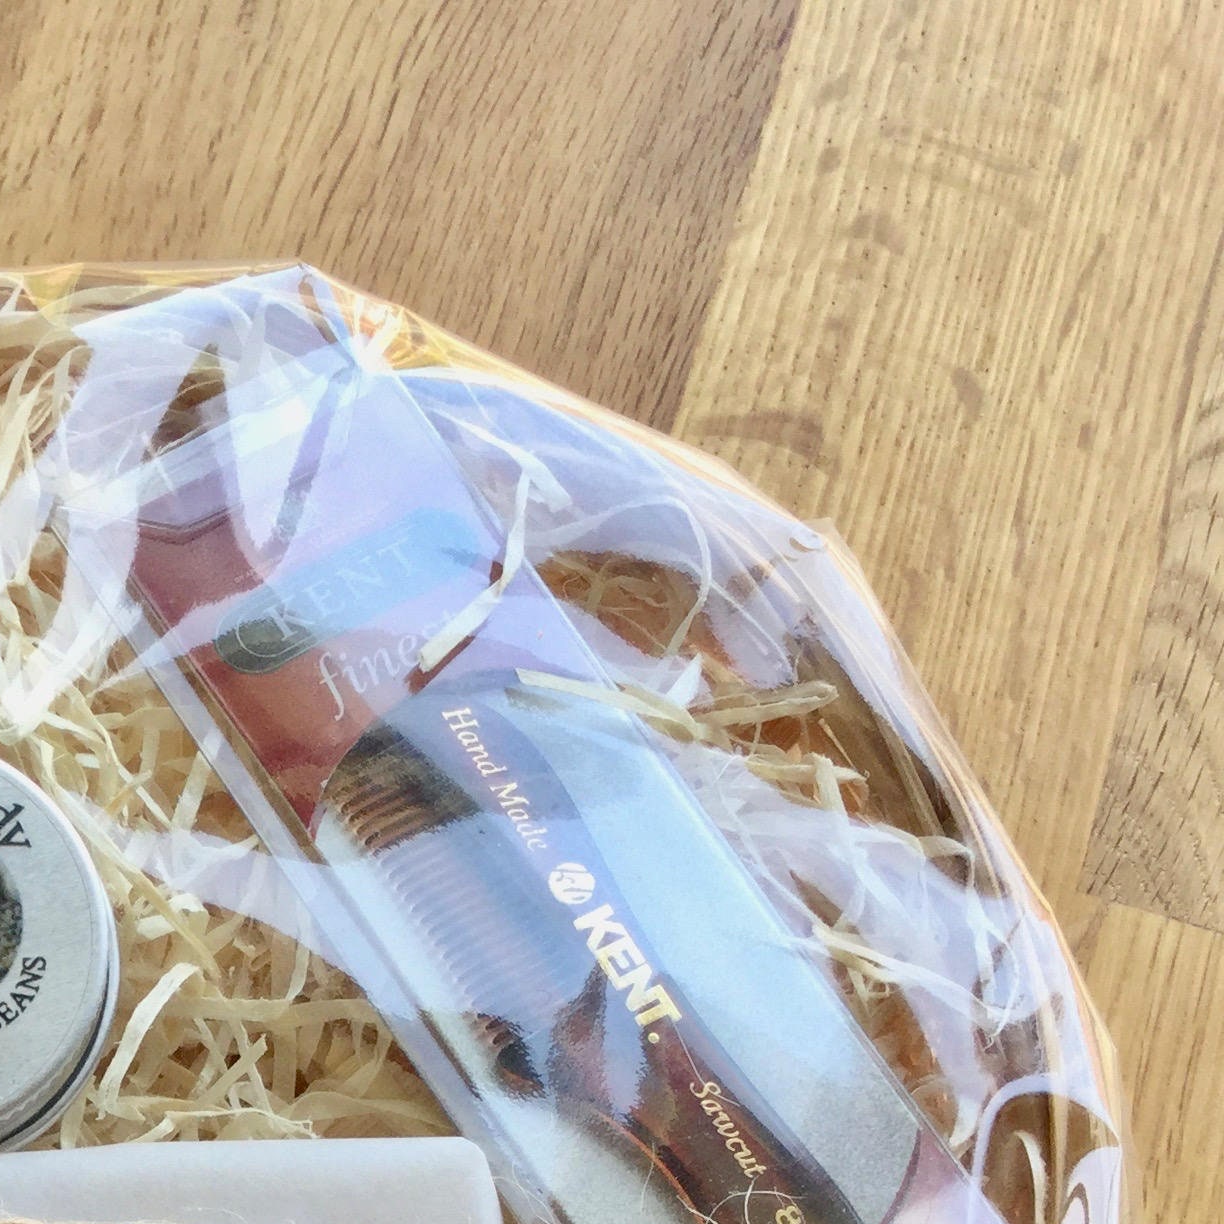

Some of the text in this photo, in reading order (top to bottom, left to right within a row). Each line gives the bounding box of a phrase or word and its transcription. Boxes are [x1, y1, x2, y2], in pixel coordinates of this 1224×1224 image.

[263, 538, 416, 640] KENT
[317, 610, 452, 721] fine
[441, 707, 549, 852] Hand Made
[689, 1081, 769, 1180] Sawcut
